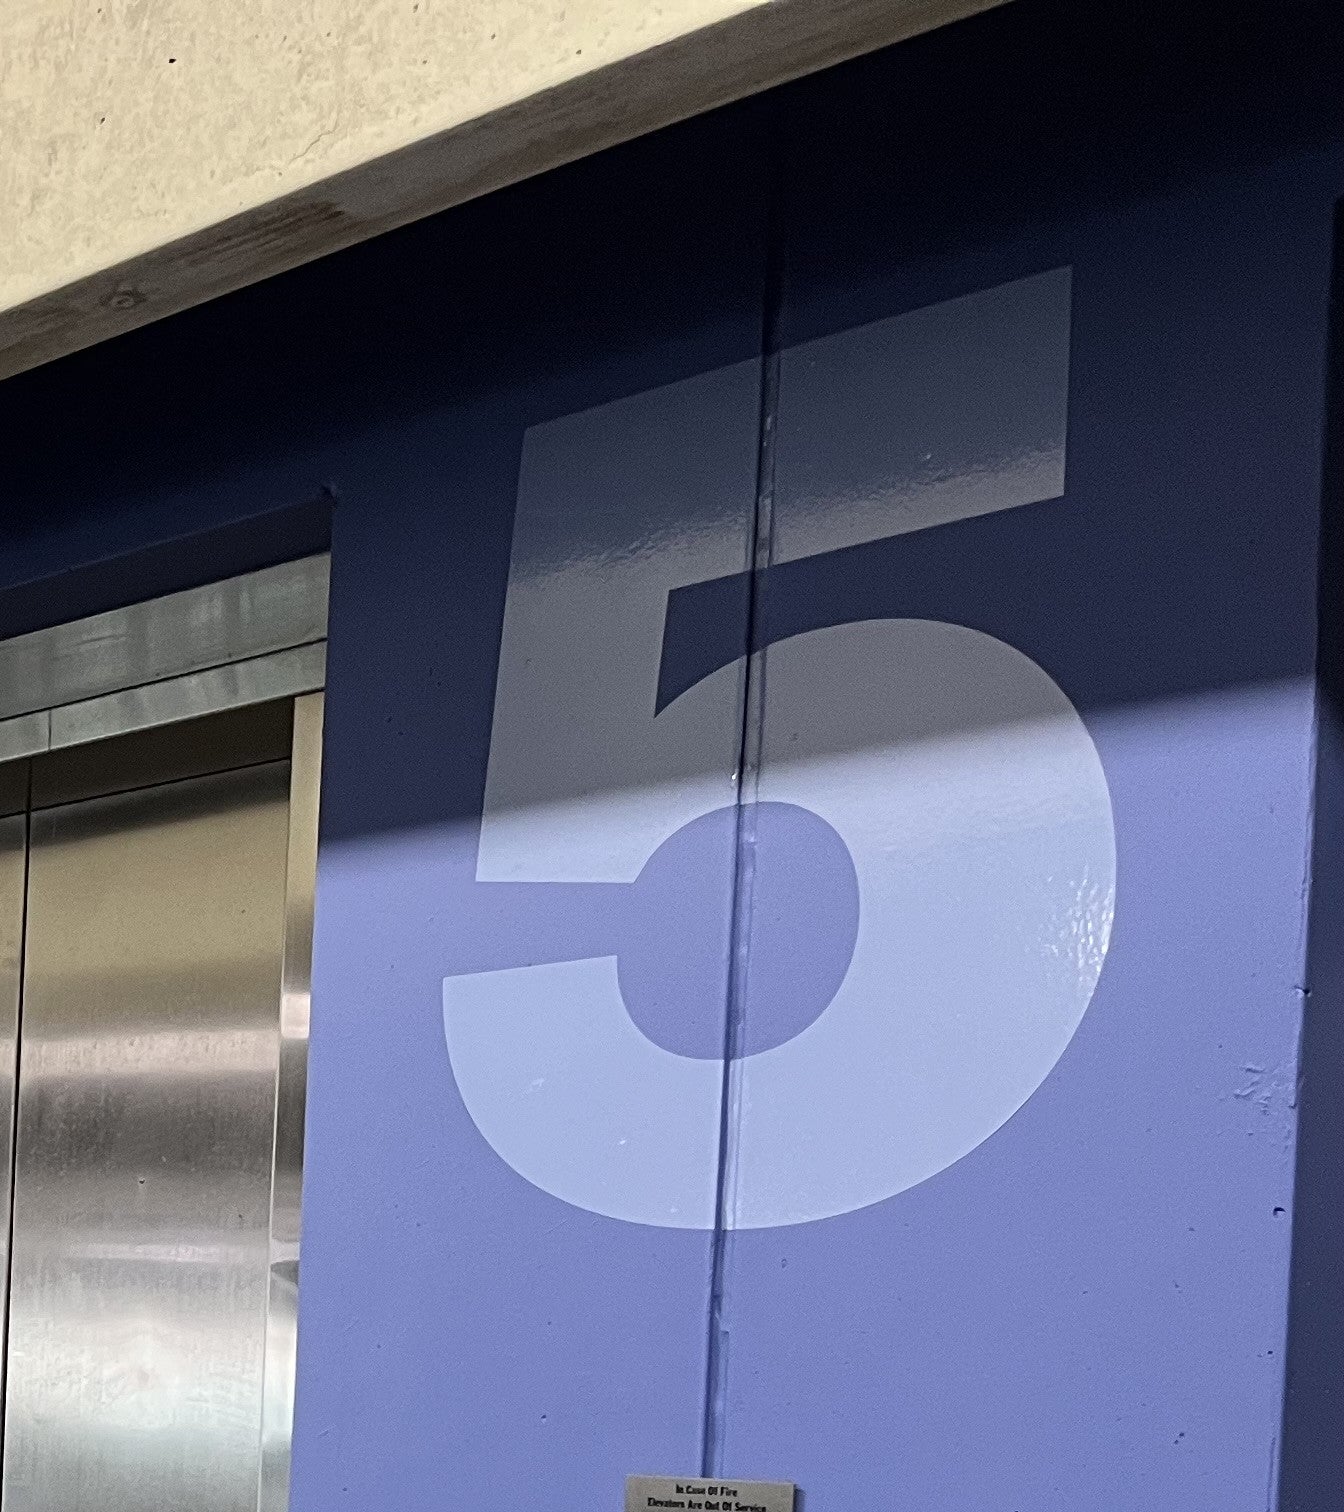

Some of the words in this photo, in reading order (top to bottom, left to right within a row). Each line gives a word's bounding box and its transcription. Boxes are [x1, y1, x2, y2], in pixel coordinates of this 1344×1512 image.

[442, 264, 1116, 1230] 5
[675, 1483, 684, 1494] In
[685, 1485, 706, 1495] Case
[708, 1486, 719, 1496] Of
[720, 1486, 738, 1497] Fire
[647, 1497, 685, 1509] Elevators
[687, 1499, 703, 1510] Are
[704, 1500, 720, 1511] Out
